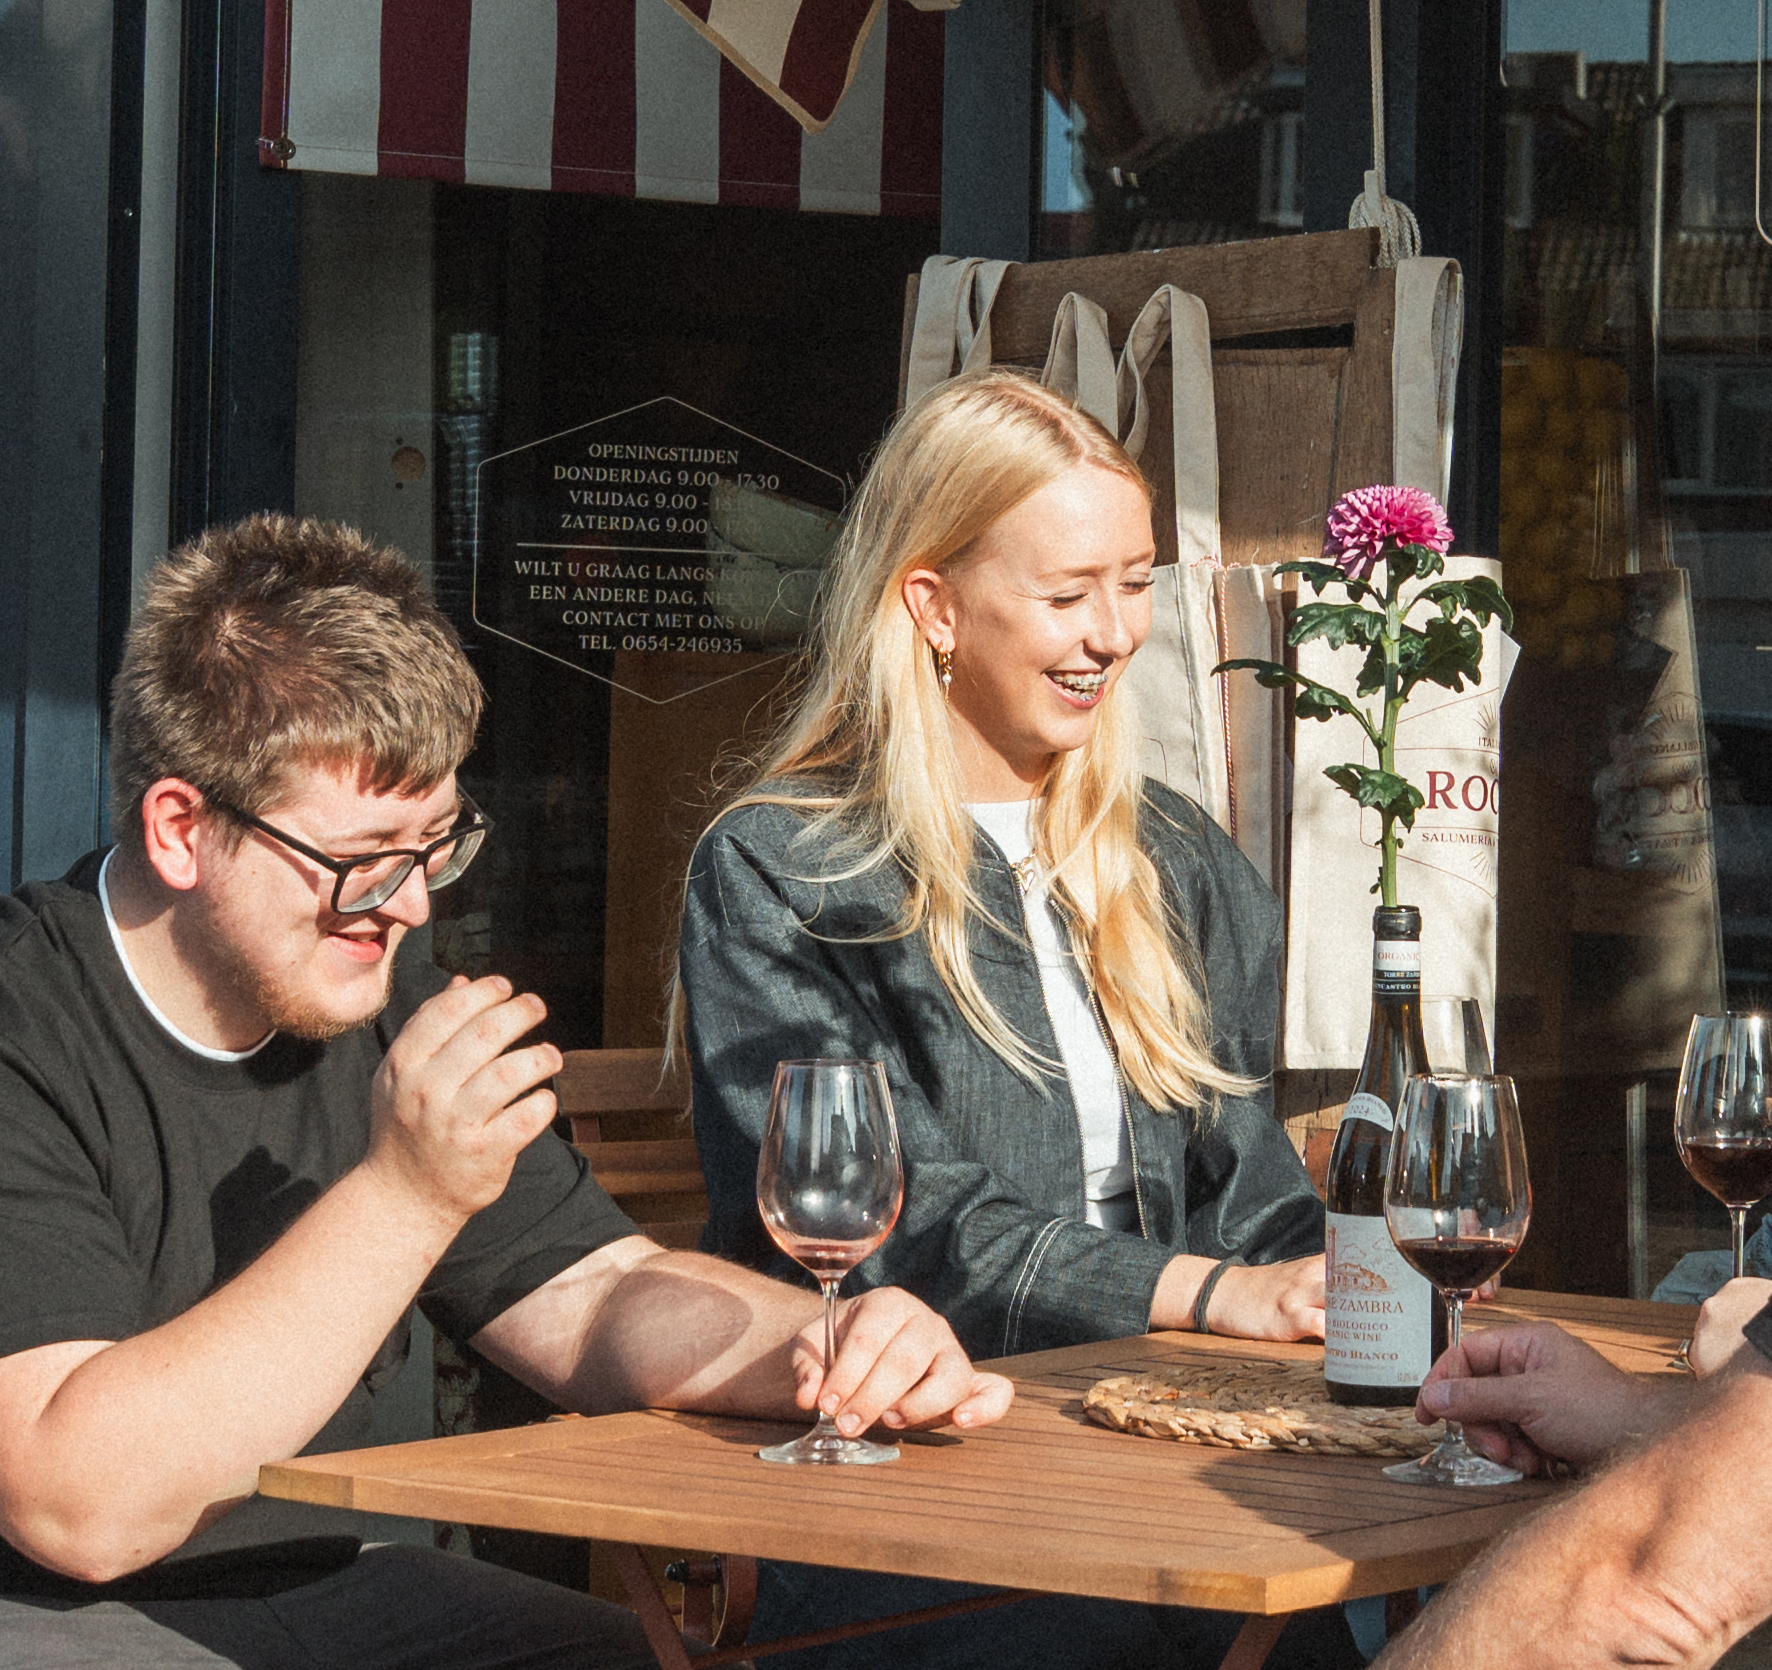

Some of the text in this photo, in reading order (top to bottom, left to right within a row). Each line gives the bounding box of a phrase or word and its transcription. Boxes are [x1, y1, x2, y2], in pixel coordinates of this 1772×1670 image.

[589, 443, 739, 464] OPENINGSTIJDEN
[554, 465, 780, 490] DONDERDAG 9.00 1730
[569, 489, 650, 508] VRIJDAG
[655, 492, 697, 510] 9.00
[561, 513, 660, 532] ZATERDAG
[666, 516, 708, 534] 9.00
[515, 560, 563, 576] WILT
[568, 562, 581, 577] U
[585, 562, 650, 579] GRAAG
[656, 565, 715, 581] LANGS
[530, 585, 566, 600] EEN
[573, 586, 649, 603] ANDERE
[655, 589, 697, 606] DAG,
[562, 610, 650, 627] CONTACT
[655, 613, 694, 628] MET
[698, 614, 735, 630] ONS
[579, 634, 743, 653] TEL. 0654-246935
[1340, 1298, 1404, 1314] ZAMBRA
[1332, 1319, 1389, 1331] BIOLOGICO
[1353, 1332, 1382, 1342] WINE
[1350, 1350, 1399, 1361] BIANCO
